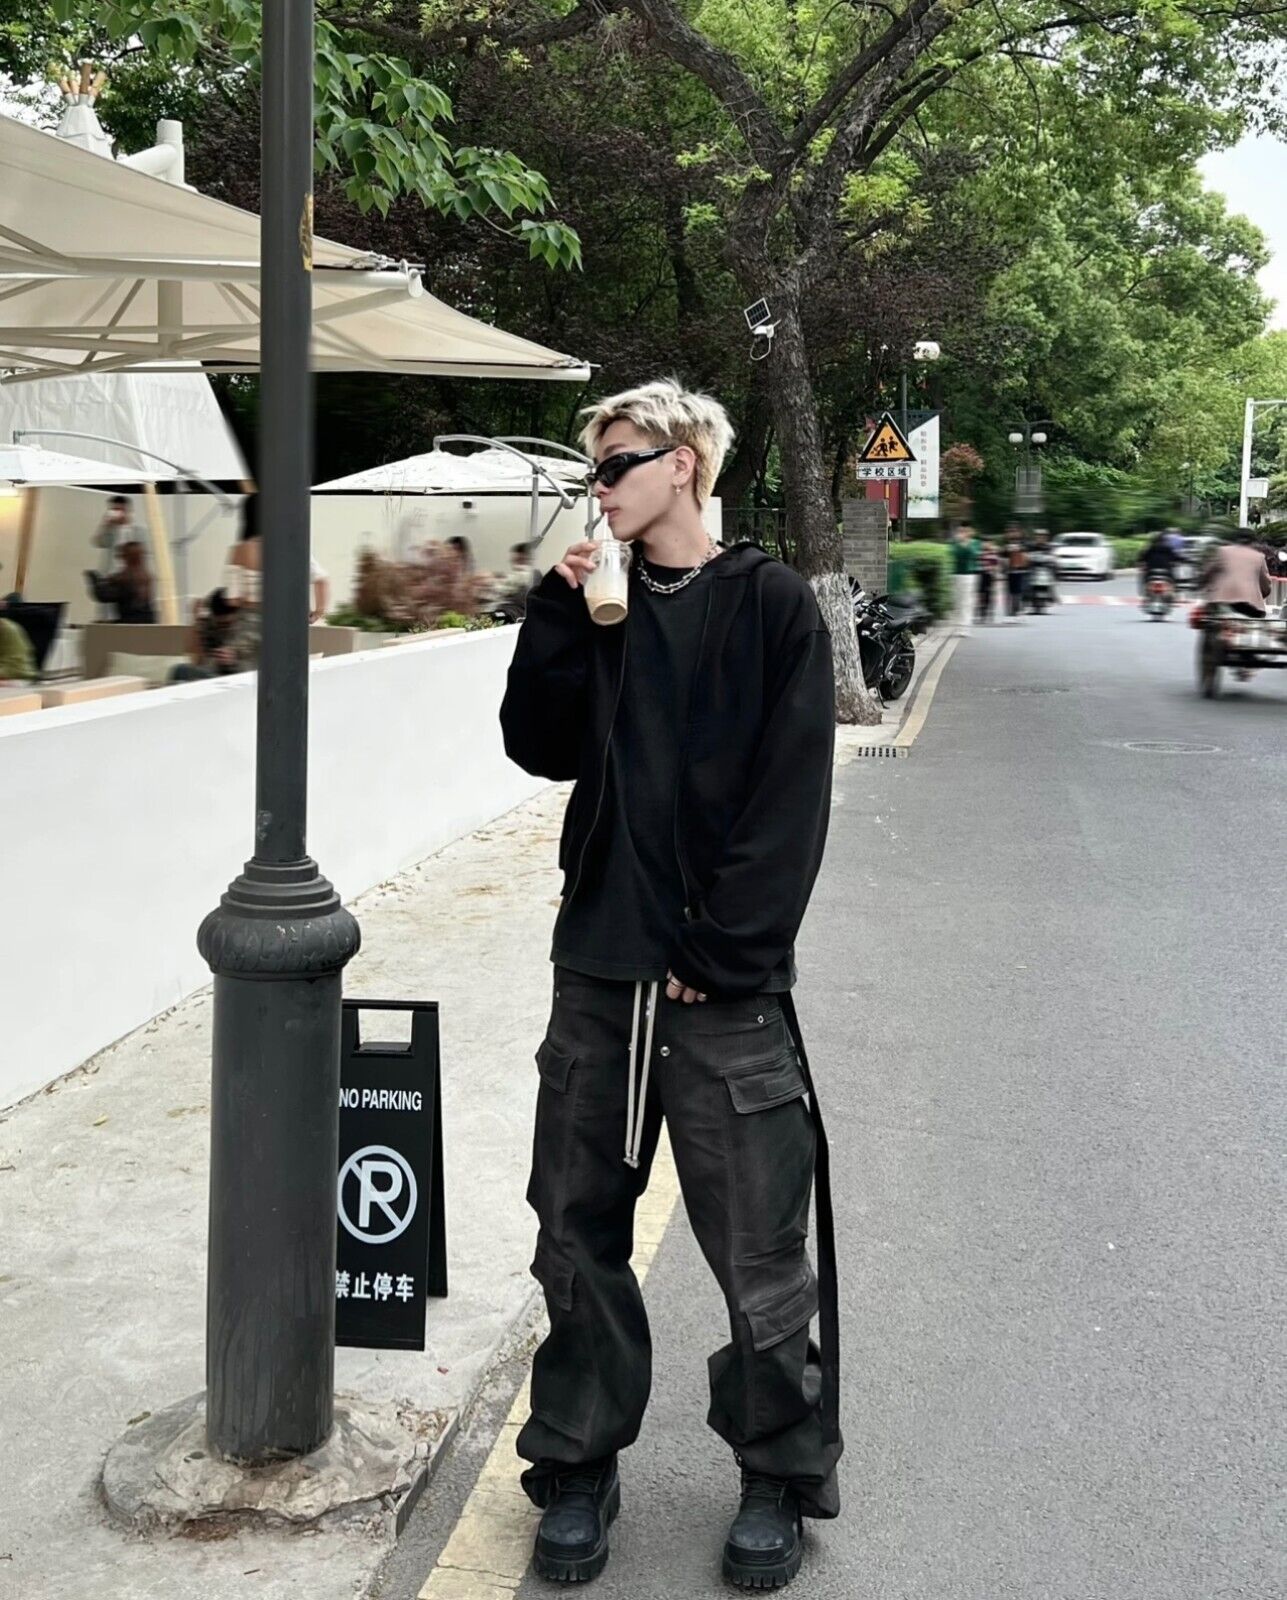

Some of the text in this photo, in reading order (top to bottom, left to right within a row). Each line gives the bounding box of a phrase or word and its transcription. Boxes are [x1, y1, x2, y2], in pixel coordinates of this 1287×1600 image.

[861, 467, 907, 477] 学校区域
[339, 1087, 423, 1111] NO PARKING
[335, 1269, 415, 1303] 禁止停车
